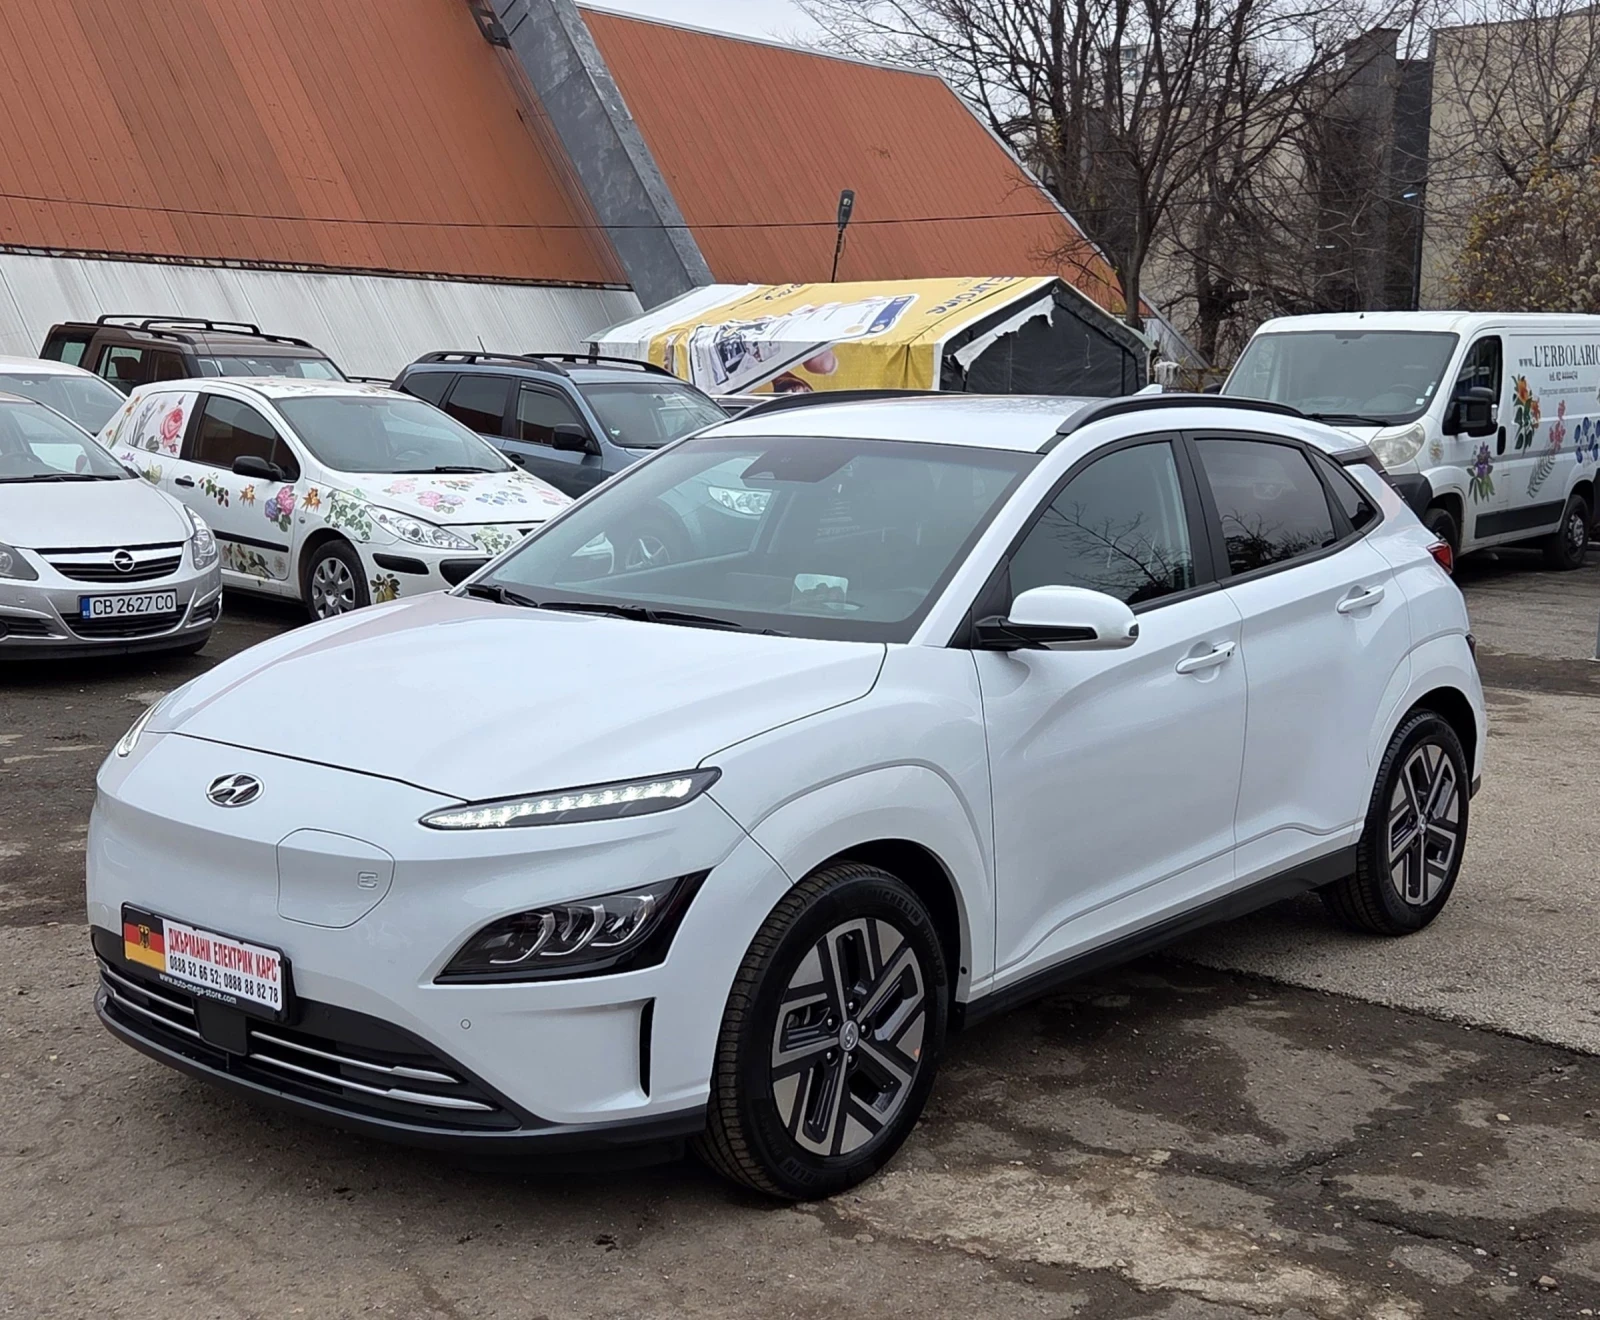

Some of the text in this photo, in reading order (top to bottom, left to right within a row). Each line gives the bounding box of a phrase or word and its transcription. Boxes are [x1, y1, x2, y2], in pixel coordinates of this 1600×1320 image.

[93, 594, 174, 615] CB 2627 CO
[169, 928, 277, 982] ДЖЪРМАНИ ЕЛЕКТРИК КАРС
[170, 955, 186, 974] 0888
[188, 961, 197, 978] 52
[225, 973, 242, 992] 0888
[246, 979, 254, 996] 88
[257, 983, 266, 1000] 82
[269, 986, 279, 1003] 78
